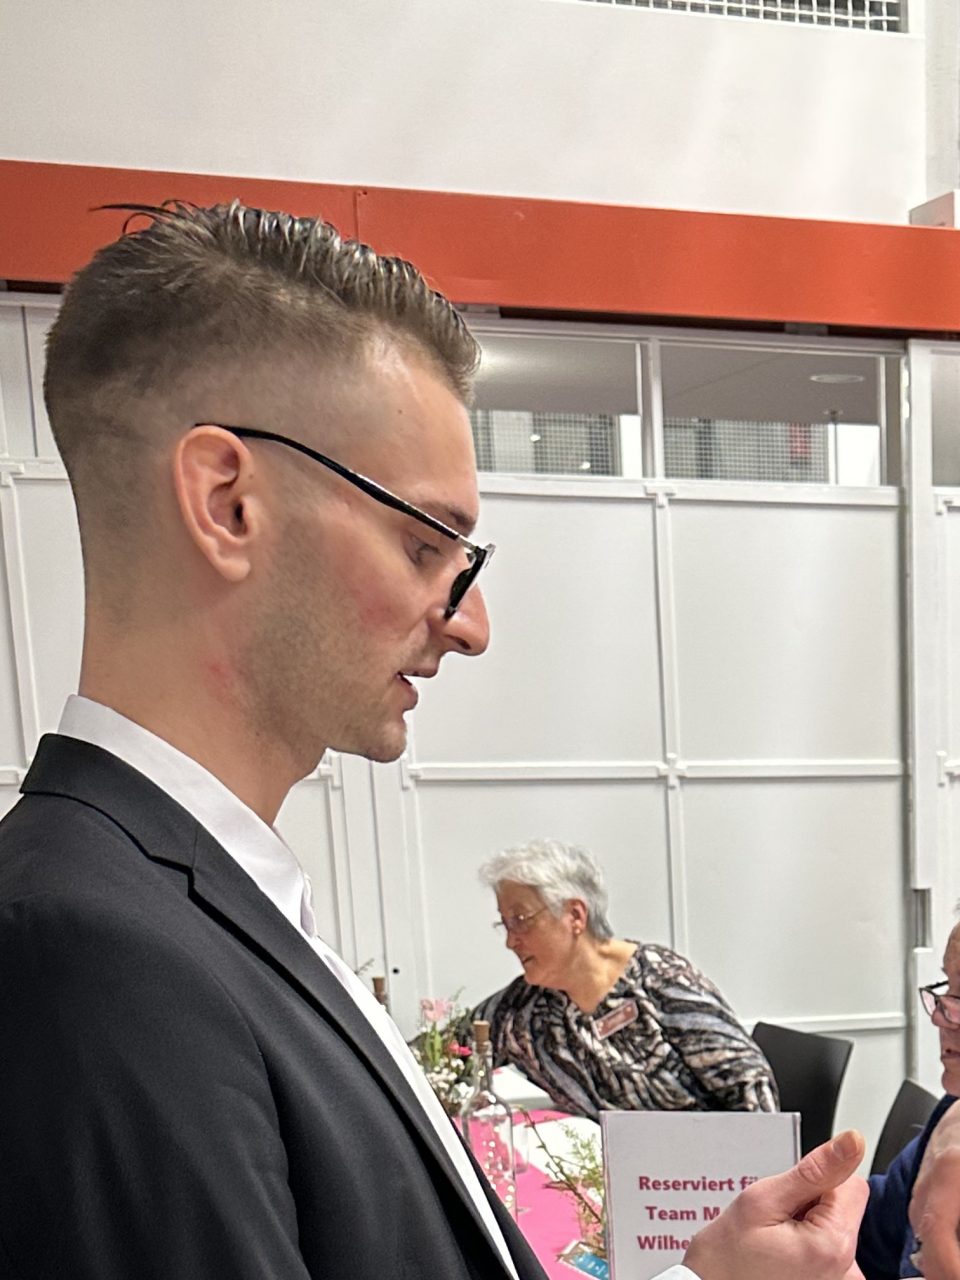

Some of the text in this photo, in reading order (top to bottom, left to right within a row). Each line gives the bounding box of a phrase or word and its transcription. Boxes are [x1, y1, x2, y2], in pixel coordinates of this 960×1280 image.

[638, 1176, 735, 1191] Reserviert
[645, 1206, 697, 1220] Team
[637, 1235, 692, 1250] Wilhe
